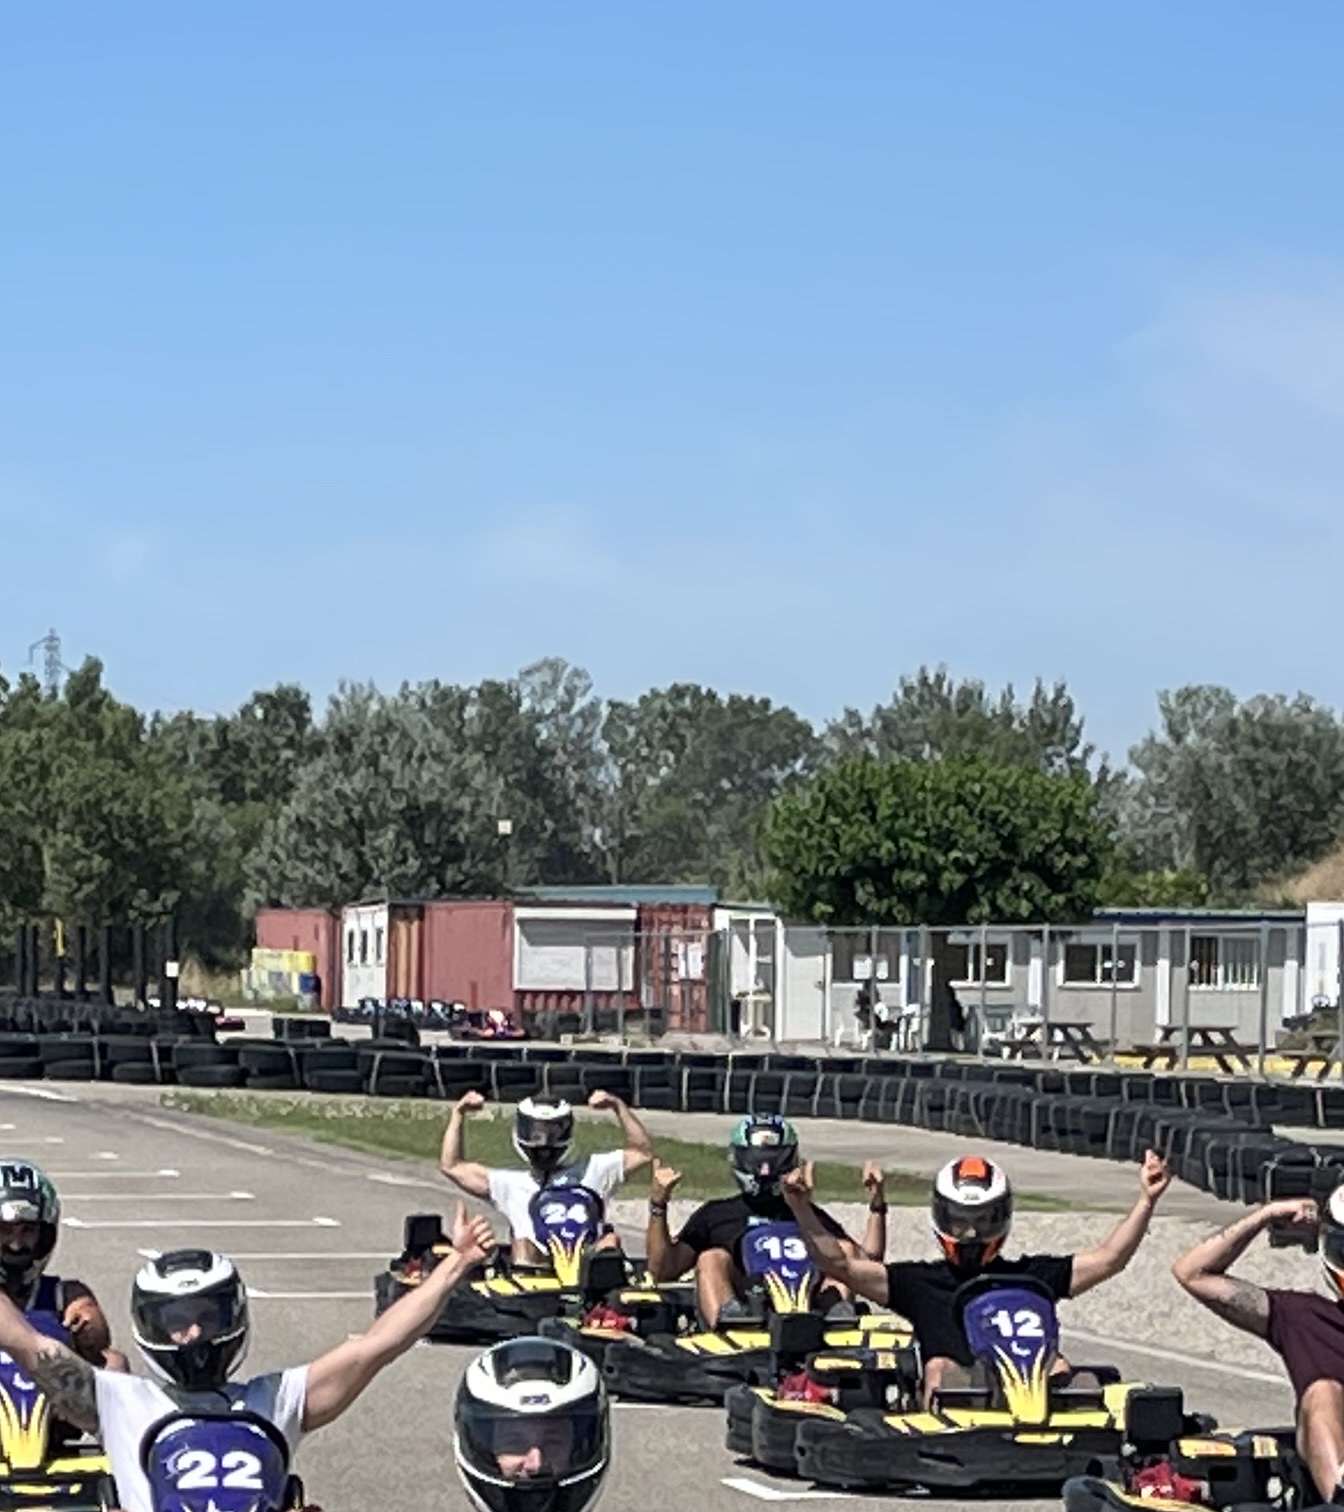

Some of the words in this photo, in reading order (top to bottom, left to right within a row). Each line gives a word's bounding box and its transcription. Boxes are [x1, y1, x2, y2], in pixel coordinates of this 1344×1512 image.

[542, 1203, 588, 1224] 24
[762, 1236, 808, 1260] 13
[991, 1310, 1045, 1337] 12
[176, 1450, 263, 1489] 22
